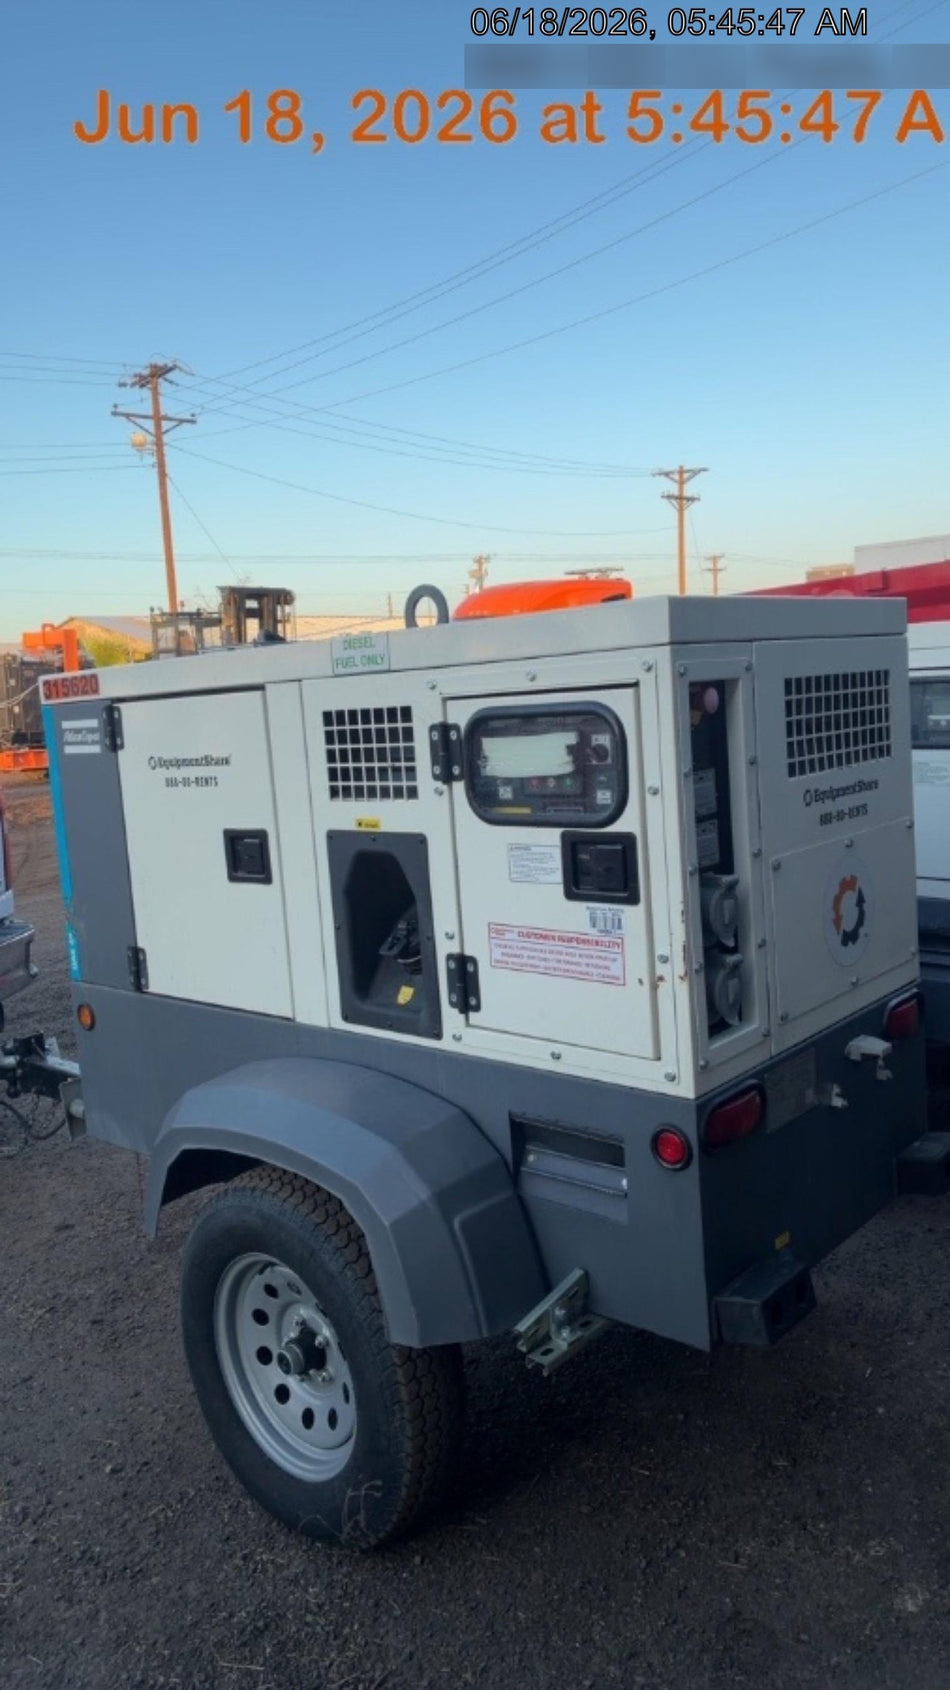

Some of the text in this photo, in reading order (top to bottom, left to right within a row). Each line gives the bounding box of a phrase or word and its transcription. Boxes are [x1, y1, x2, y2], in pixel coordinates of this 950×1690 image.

[343, 635, 375, 650] DIESEL
[336, 653, 386, 669] FUEL ONLY
[42, 672, 101, 701] 315620
